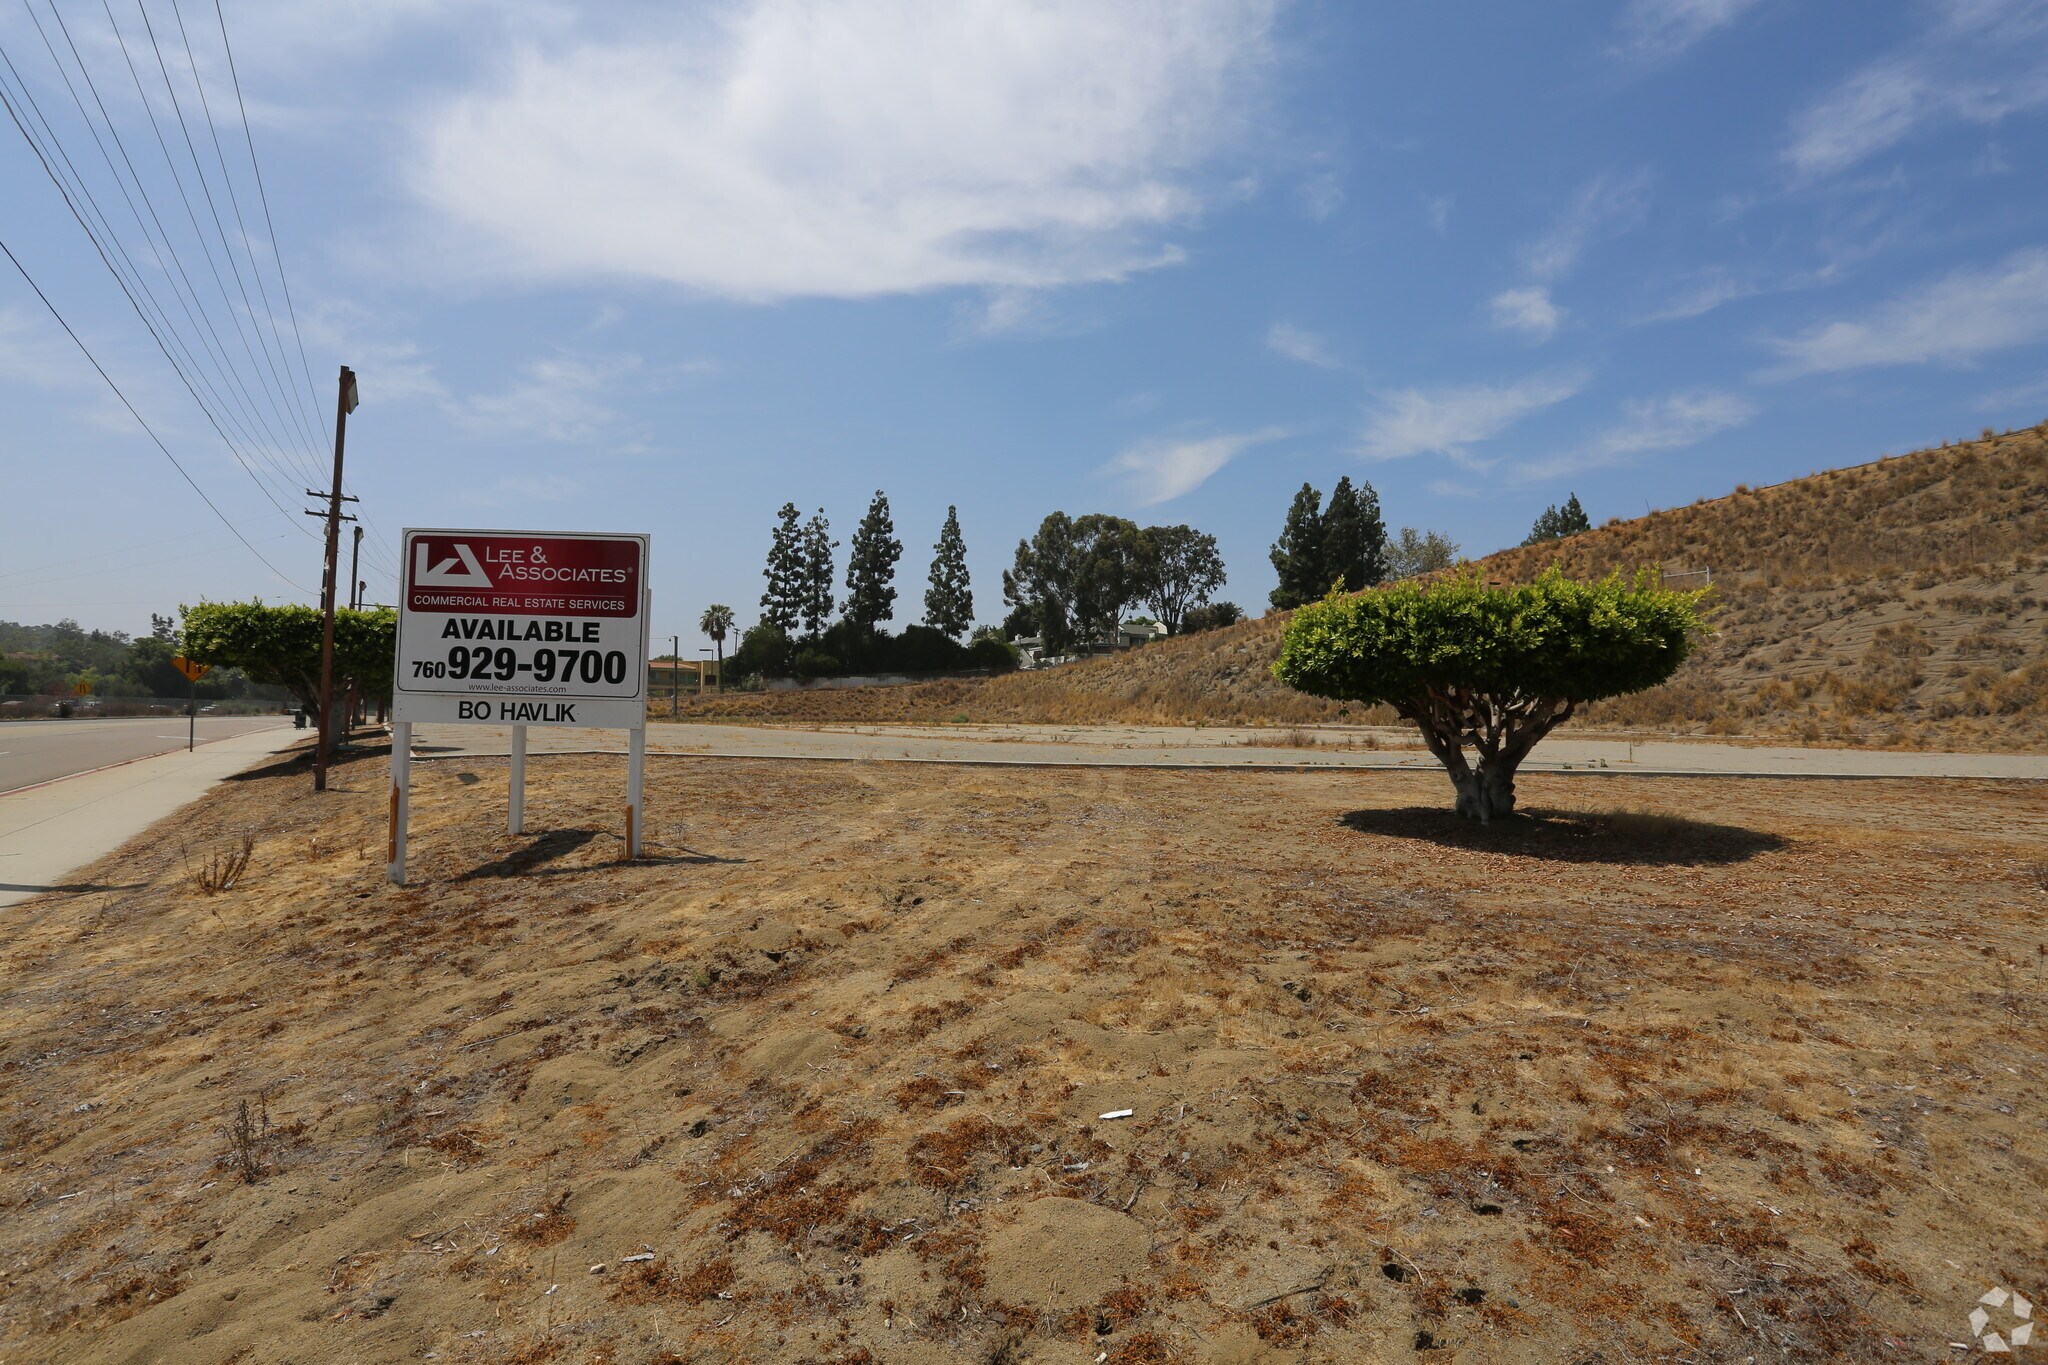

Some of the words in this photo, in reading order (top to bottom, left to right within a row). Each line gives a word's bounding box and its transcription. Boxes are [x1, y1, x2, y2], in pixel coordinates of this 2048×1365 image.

[486, 546, 525, 563] LEE
[530, 545, 548, 564] &
[414, 595, 489, 607] COMMERCIAL
[492, 597, 521, 608] REAL
[525, 598, 565, 609] ESTATE
[569, 599, 625, 611] SERVICES
[441, 618, 600, 643] AVAILABLE
[411, 660, 446, 679] 760
[448, 646, 627, 685] 929-9700
[468, 683, 567, 694] www.lee-associates.com
[458, 701, 492, 720] BO
[500, 702, 576, 722] HAVLIK
